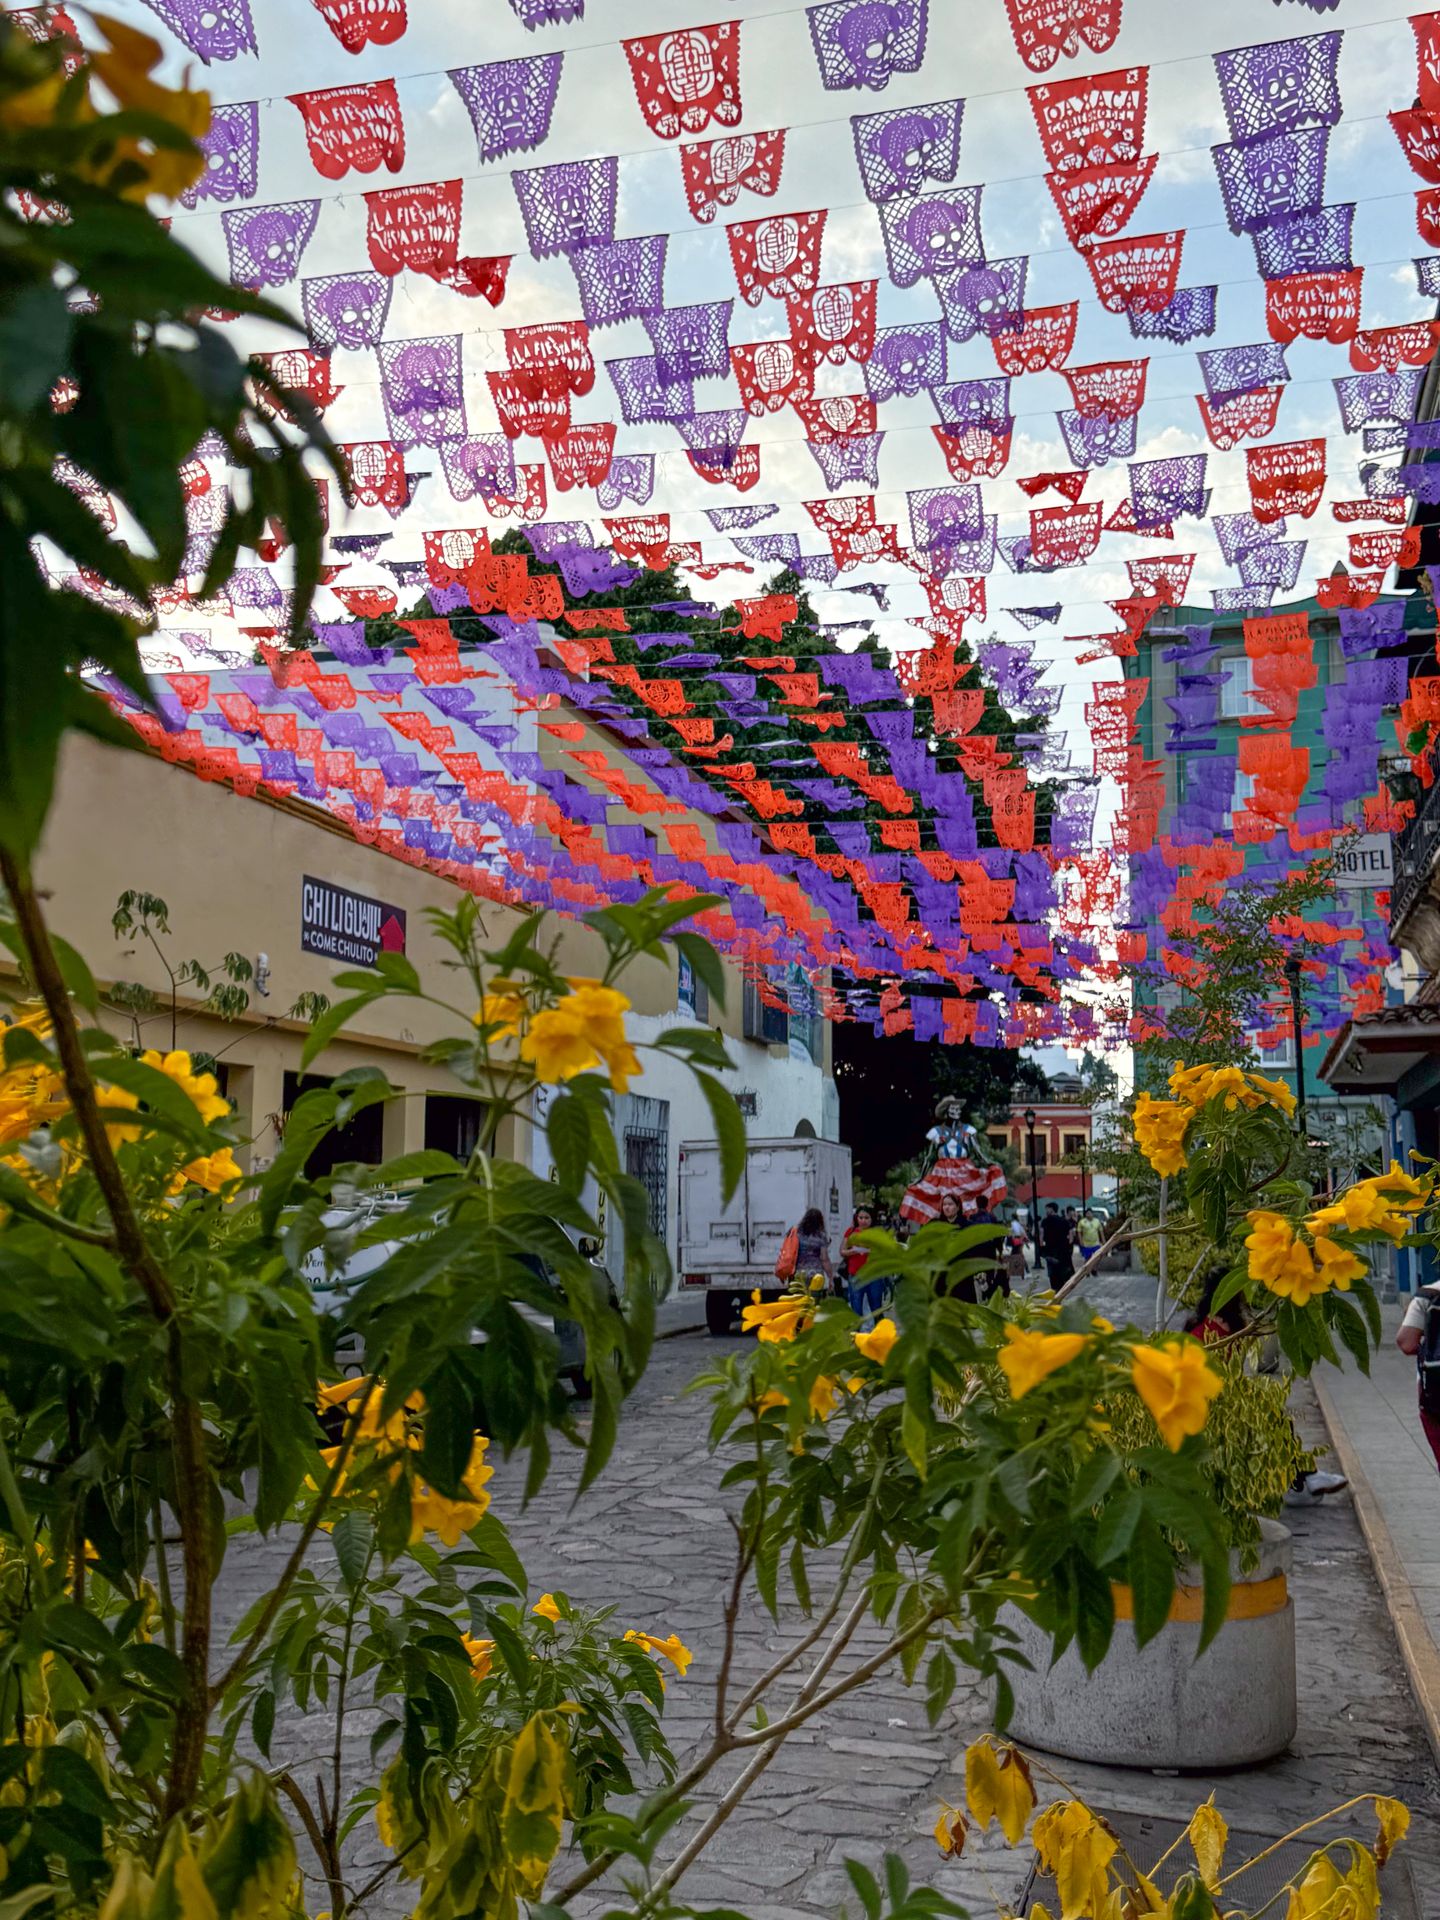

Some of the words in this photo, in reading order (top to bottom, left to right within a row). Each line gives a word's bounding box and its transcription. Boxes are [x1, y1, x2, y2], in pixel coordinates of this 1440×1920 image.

[1043, 90, 1139, 124] OAXACA
[397, 205, 437, 226] FIESTA
[437, 201, 456, 224] MÁS
[411, 226, 425, 242] DE
[1095, 248, 1176, 271] OAXACA
[1297, 288, 1336, 304] FIESTA
[534, 339, 571, 359] FIESTA
[1072, 368, 1143, 386] OAXACA
[1036, 514, 1098, 533] OAXACA
[1335, 850, 1390, 873] HOTEL
[311, 931, 336, 952] COME
[338, 940, 373, 962] CHULITO
